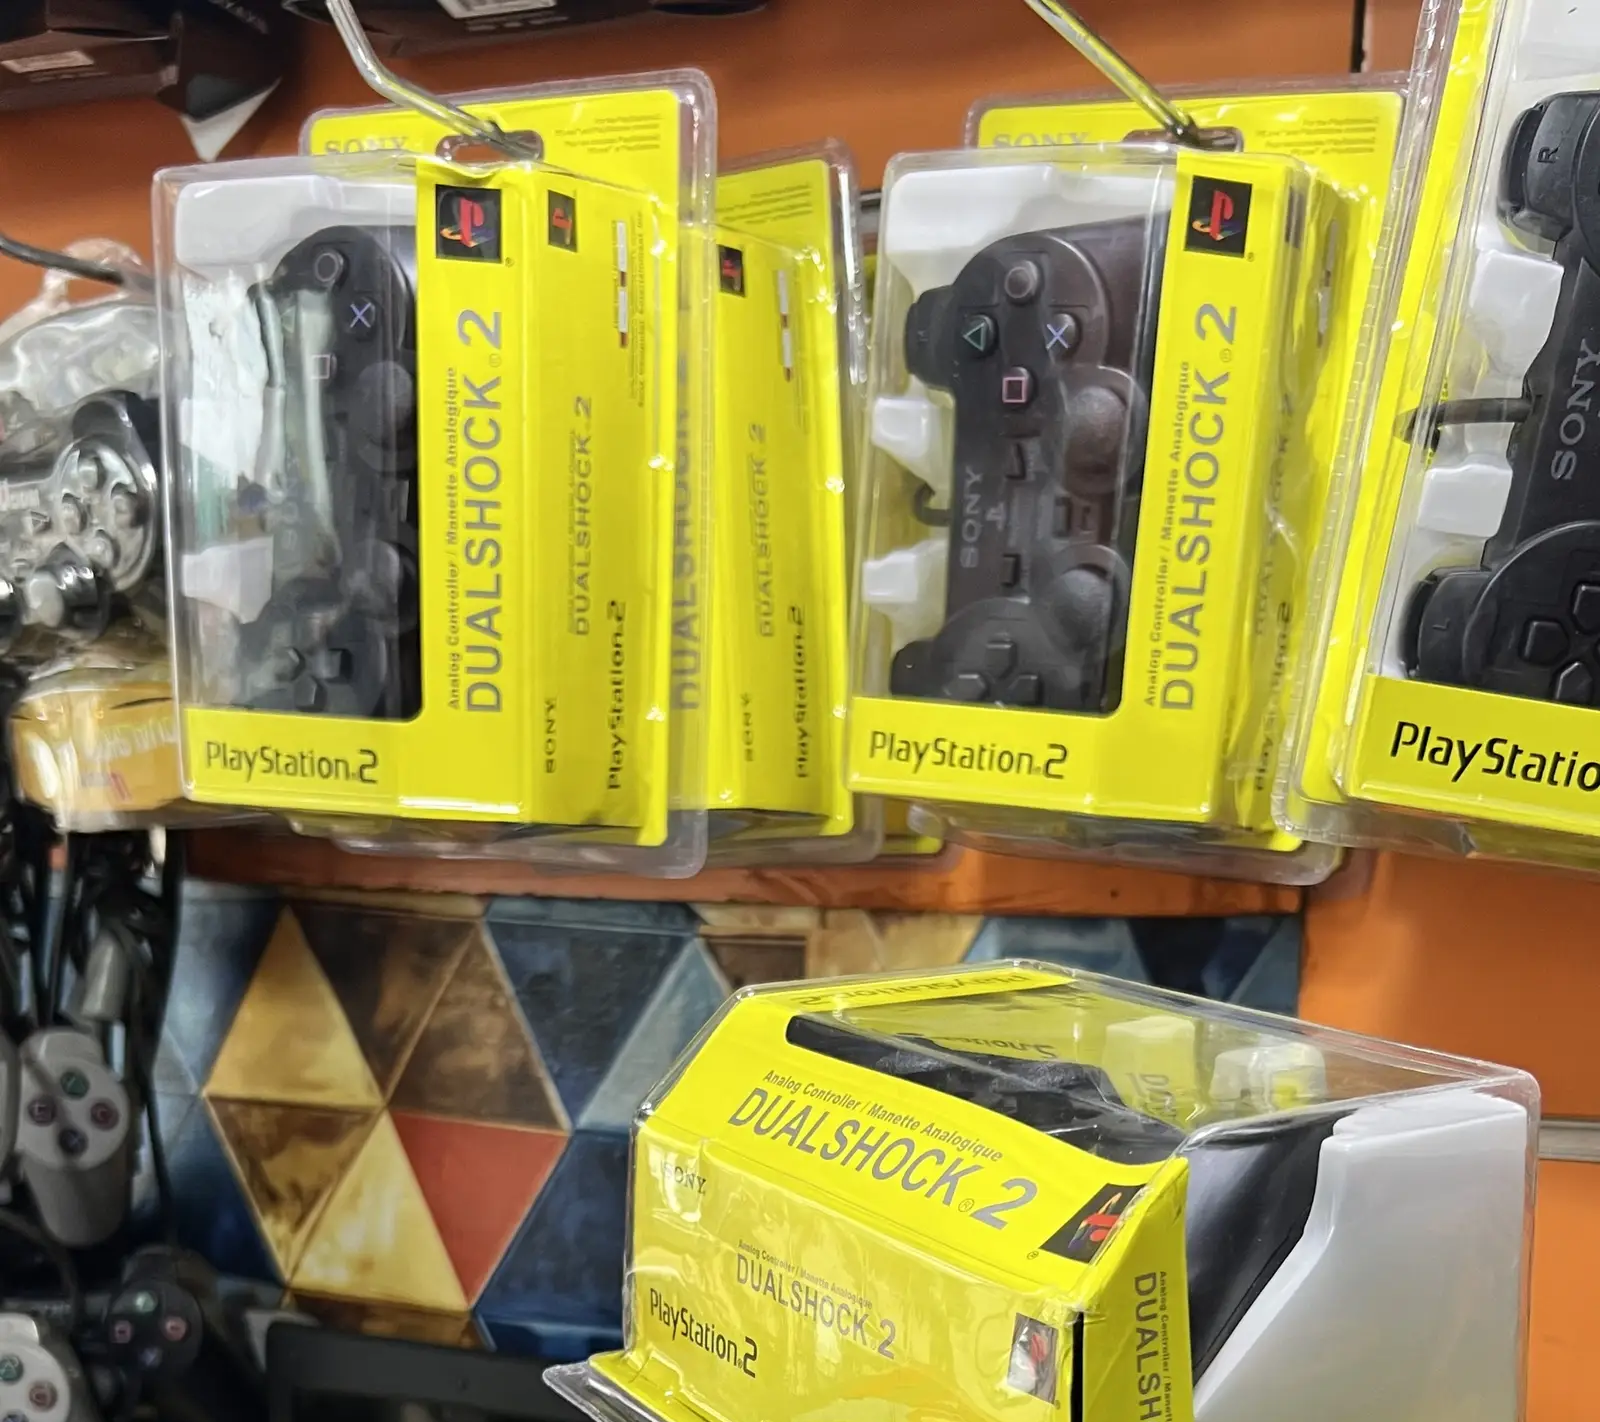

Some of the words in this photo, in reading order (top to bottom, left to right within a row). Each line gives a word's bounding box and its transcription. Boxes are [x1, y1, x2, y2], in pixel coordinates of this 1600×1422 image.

[444, 367, 461, 468] Analogique
[1551, 338, 1600, 480] SONY
[446, 473, 460, 545] Manette
[575, 433, 592, 636] DUALSHOCK
[1160, 468, 1178, 540] Manette
[445, 560, 460, 646] Controller
[1149, 557, 1169, 643] Controller
[446, 651, 462, 709] Analog
[1144, 651, 1164, 707] Analog
[545, 698, 557, 774] SONY
[763, 1070, 802, 1094] Analog
[802, 1082, 861, 1111] Controller
[867, 1103, 921, 1131] Manette
[920, 1122, 1004, 1162] Analogique
